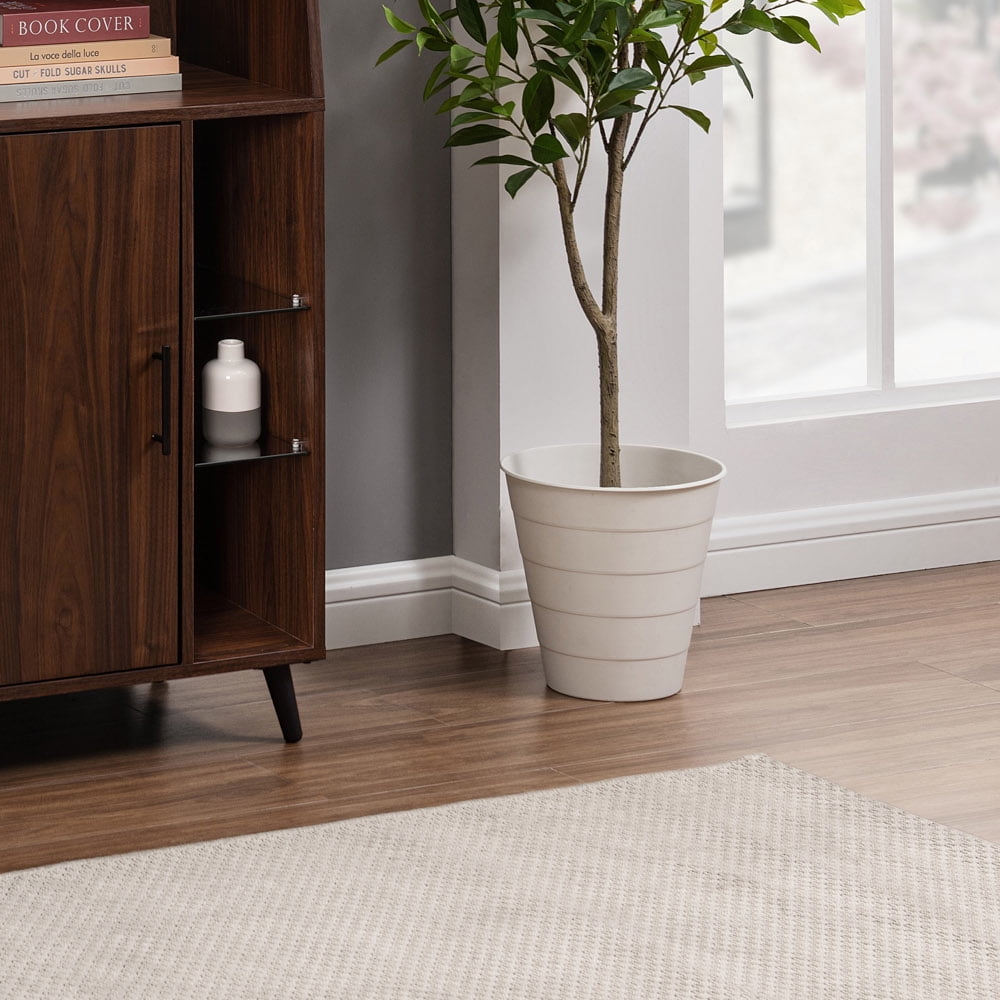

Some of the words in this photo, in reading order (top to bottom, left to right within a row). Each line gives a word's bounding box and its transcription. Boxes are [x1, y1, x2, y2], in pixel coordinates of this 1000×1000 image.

[18, 18, 70, 36] BOOK
[75, 15, 134, 33] COVER
[29, 51, 40, 61] La
[41, 51, 60, 60] voce
[61, 49, 81, 59] della
[83, 48, 100, 58] luce
[12, 69, 30, 79] CUT
[40, 67, 62, 78] FOLD
[64, 65, 93, 76] SUGAR
[94, 63, 127, 74] SKULLS
